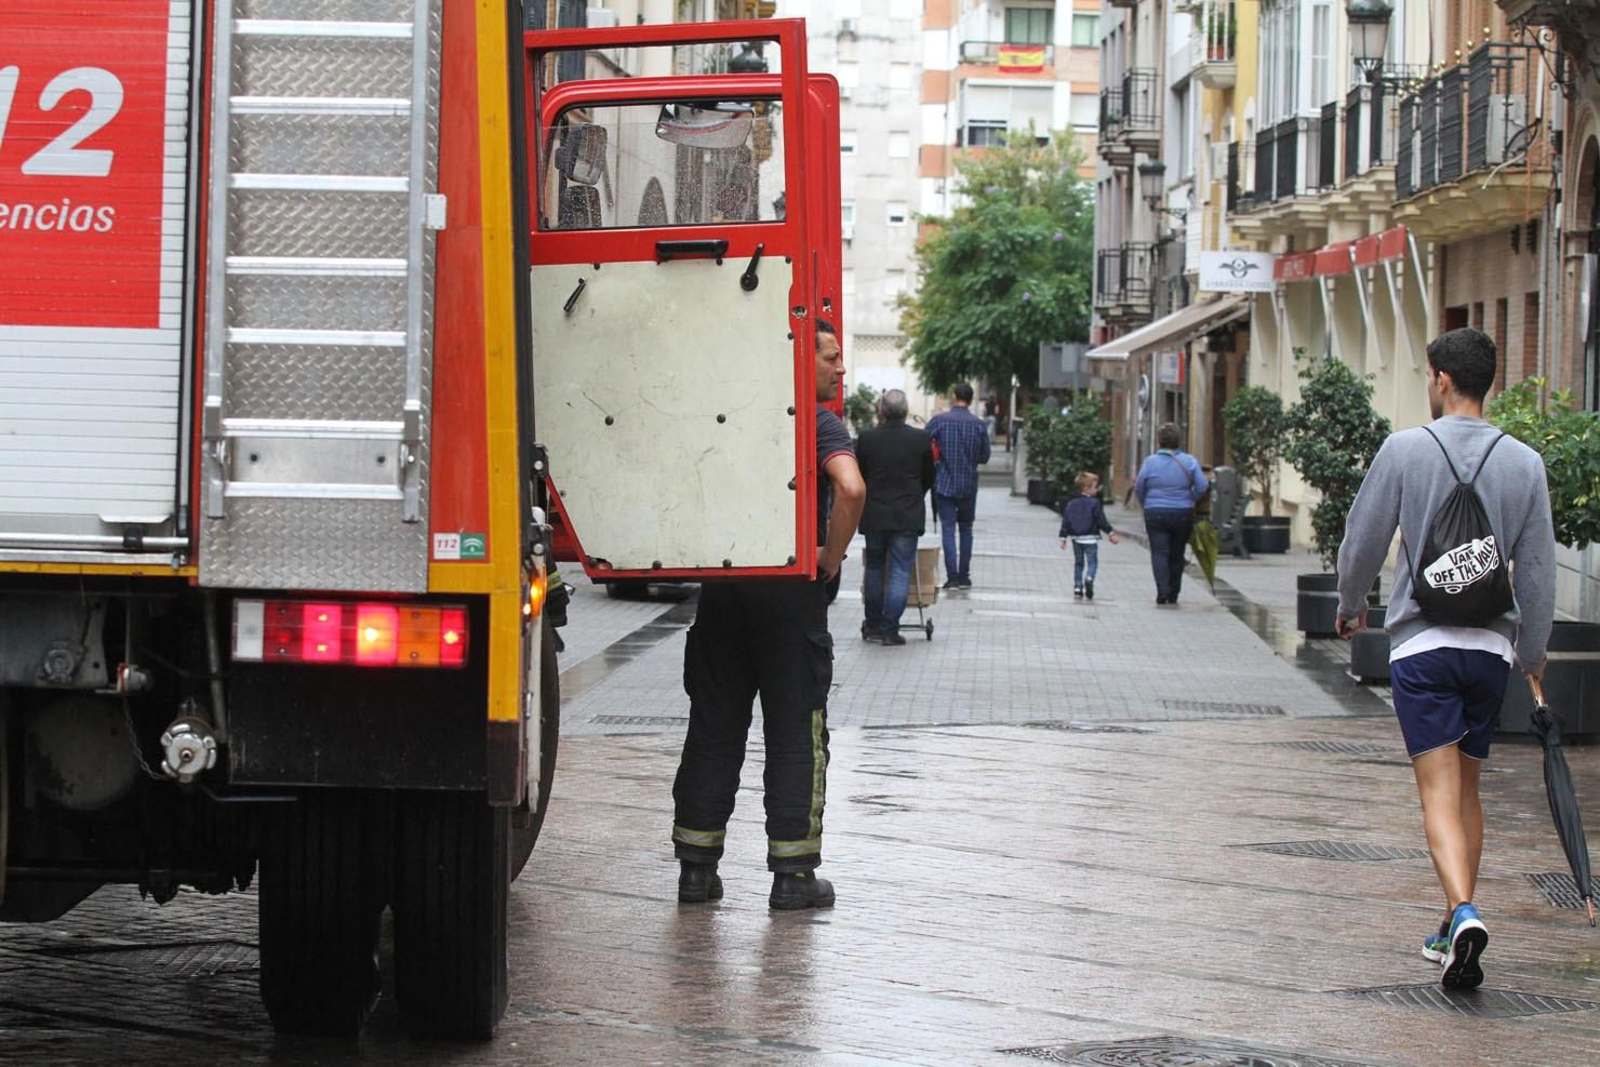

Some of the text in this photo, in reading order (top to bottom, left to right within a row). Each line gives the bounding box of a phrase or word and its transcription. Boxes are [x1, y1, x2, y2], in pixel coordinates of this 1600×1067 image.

[0, 66, 124, 177] 2
[437, 539, 458, 549] 112
[1456, 561, 1481, 580] THE
